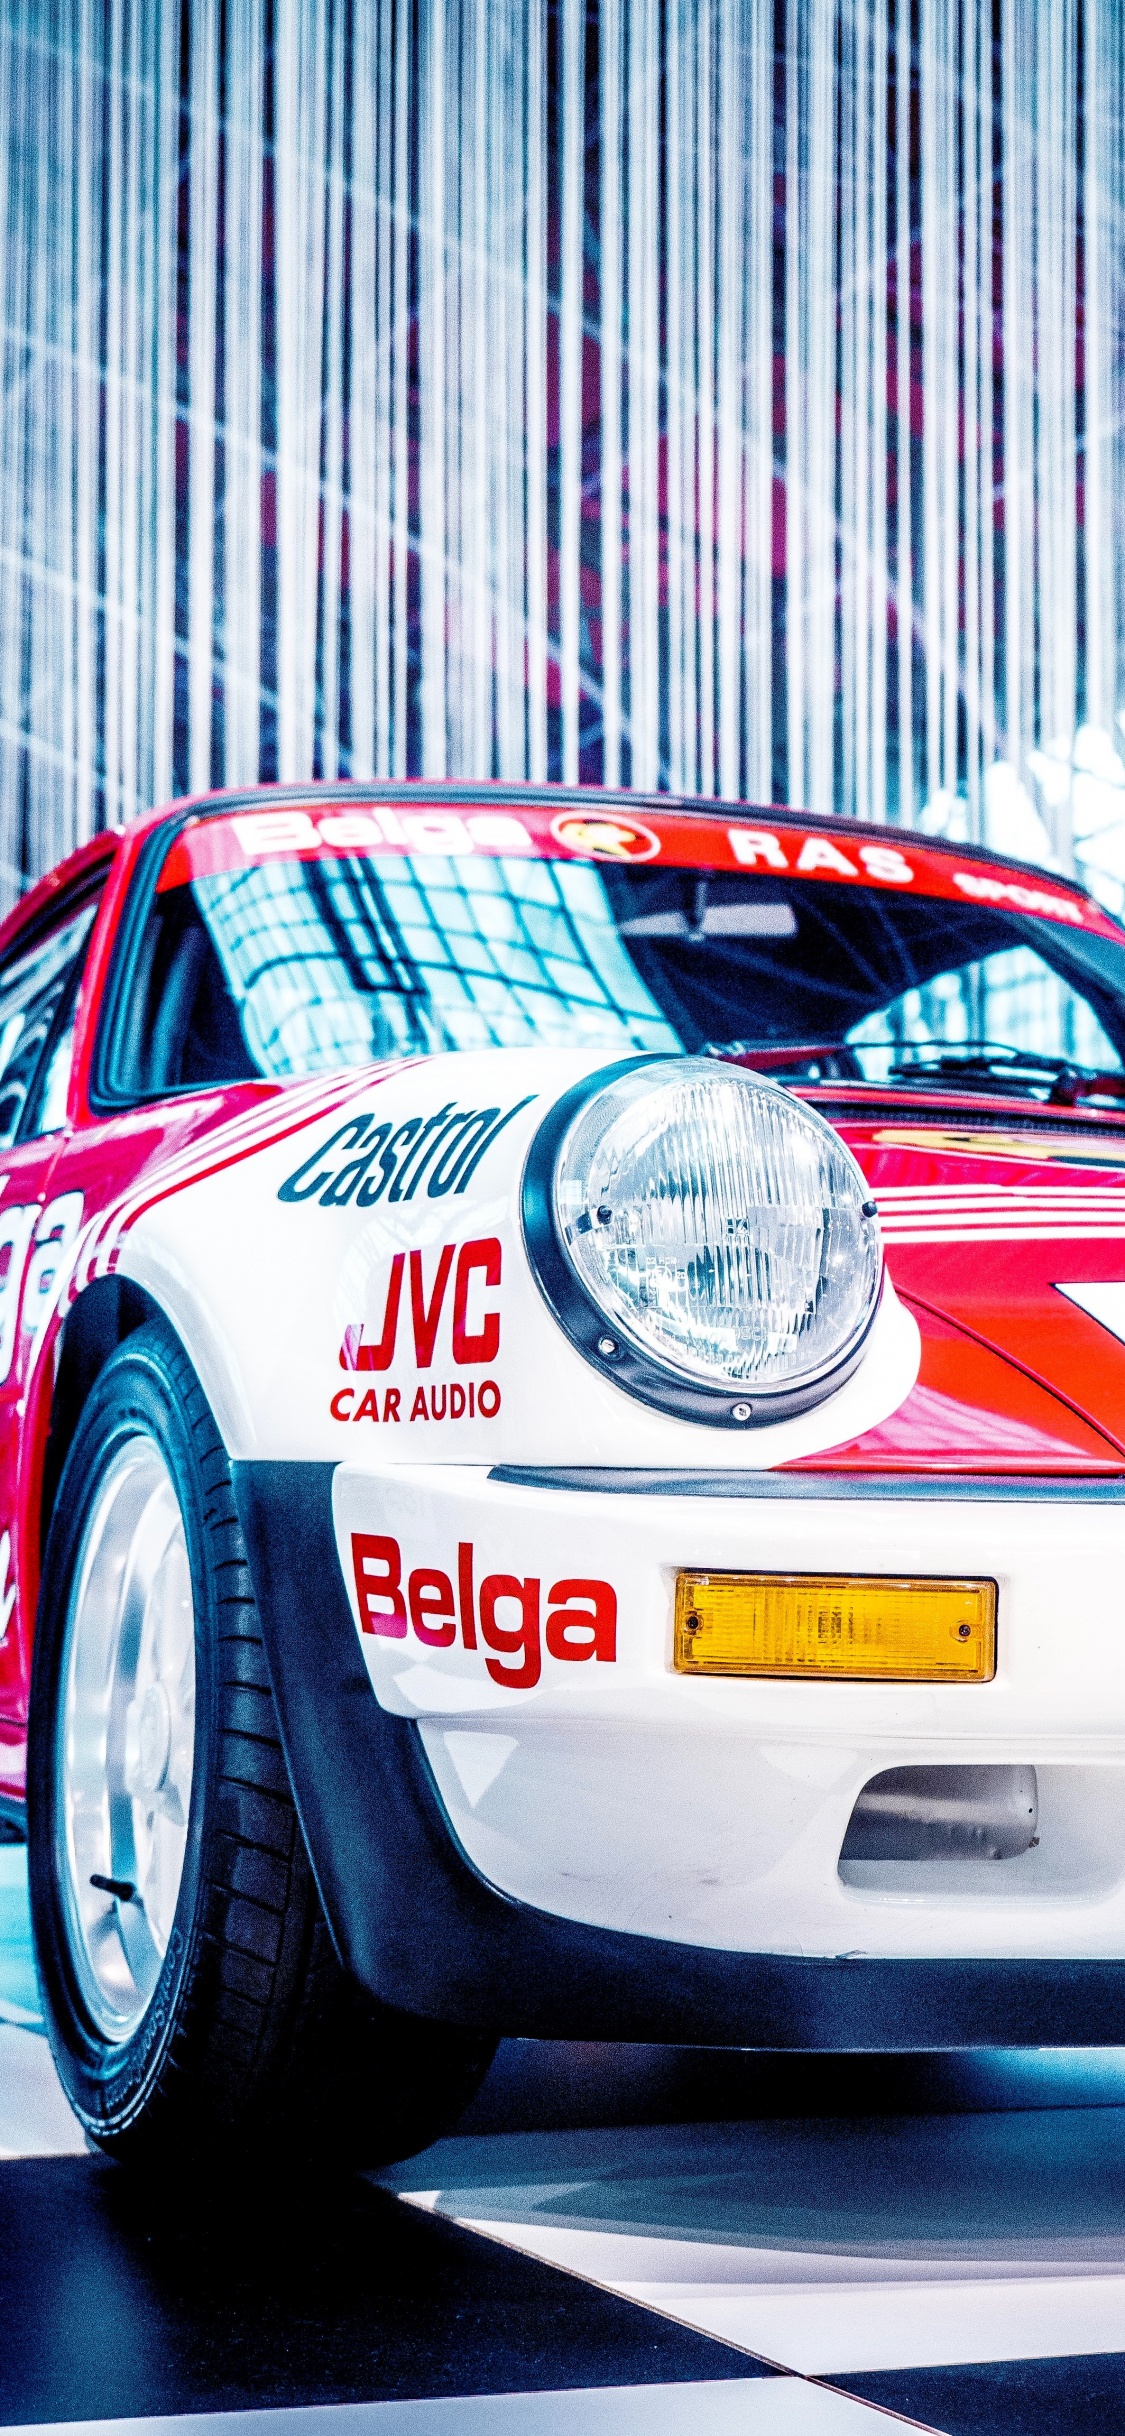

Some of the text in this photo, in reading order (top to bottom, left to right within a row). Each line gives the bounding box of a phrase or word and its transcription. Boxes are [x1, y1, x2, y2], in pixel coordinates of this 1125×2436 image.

[230, 808, 534, 856] Belga
[728, 829, 914, 883] RAS
[276, 1094, 540, 1207] Castrol
[338, 1237, 502, 1371] JVC
[329, 1380, 502, 1423] CAR AUDIO
[351, 1532, 617, 1689] Belga
